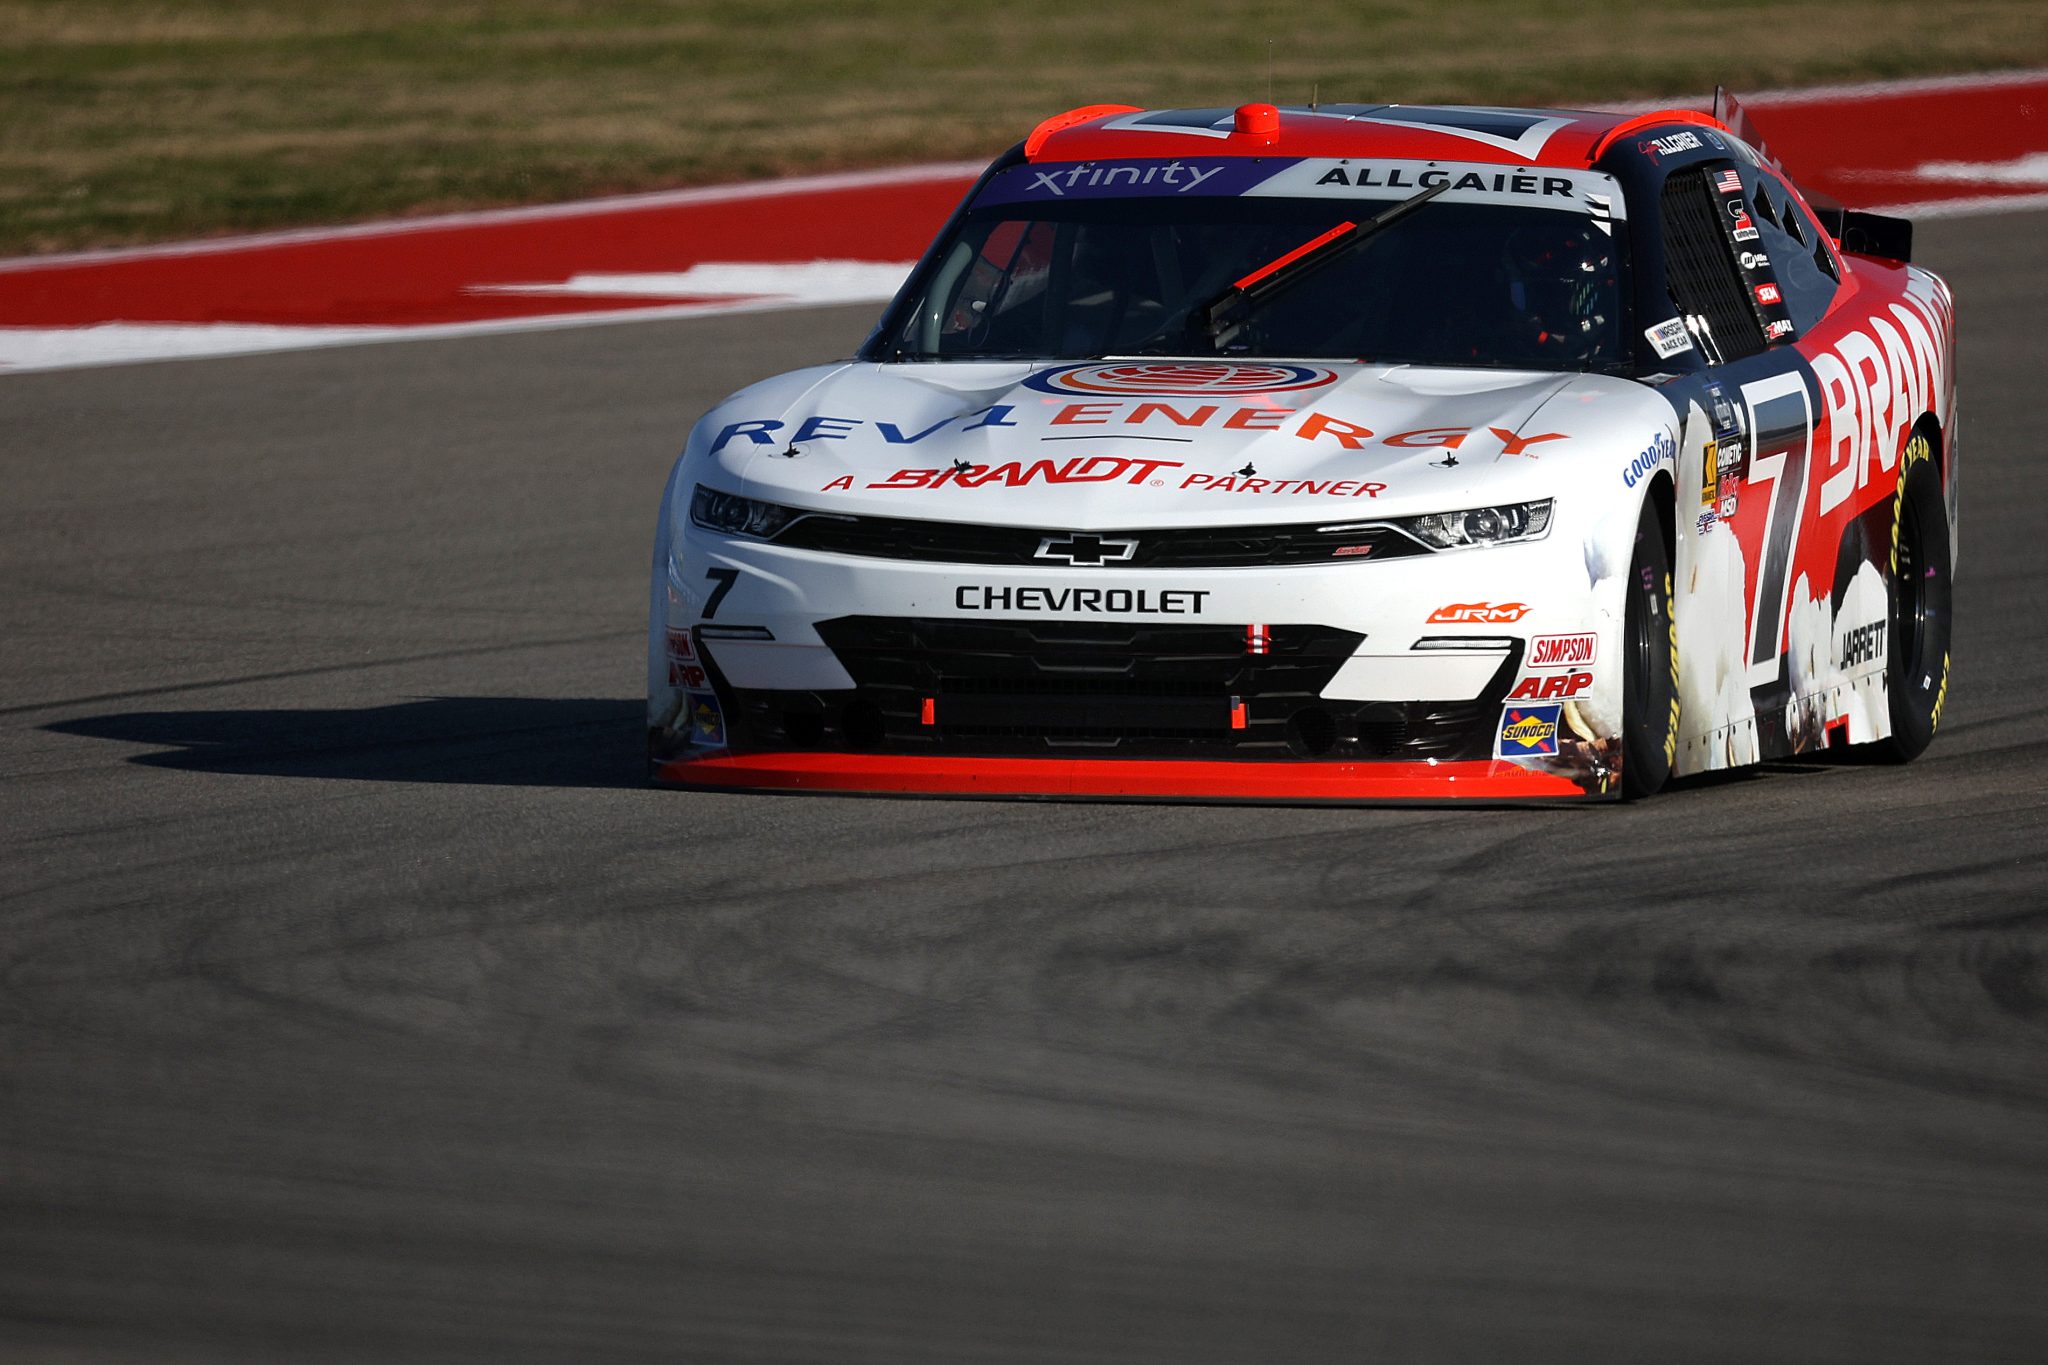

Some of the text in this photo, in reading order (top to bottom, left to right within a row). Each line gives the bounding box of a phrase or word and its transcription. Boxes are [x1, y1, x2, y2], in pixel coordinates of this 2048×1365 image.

[1026, 162, 1225, 195] xfinity
[1316, 168, 1574, 197] ALLGAIER
[1660, 339, 1679, 352] RACE
[709, 402, 1572, 456] REV1 ENERGY
[820, 457, 1387, 498] A BRANDT PARTNER
[1740, 370, 1812, 688] 7
[700, 567, 739, 619] 7
[955, 586, 1210, 613] CHEVROLET
[1434, 608, 1520, 624] JRM
[1533, 637, 1594, 663] SIMPSON
[1840, 619, 1886, 671] JARRETT
[1507, 672, 1594, 699] ARP
[1505, 723, 1553, 738] SUNOCO
